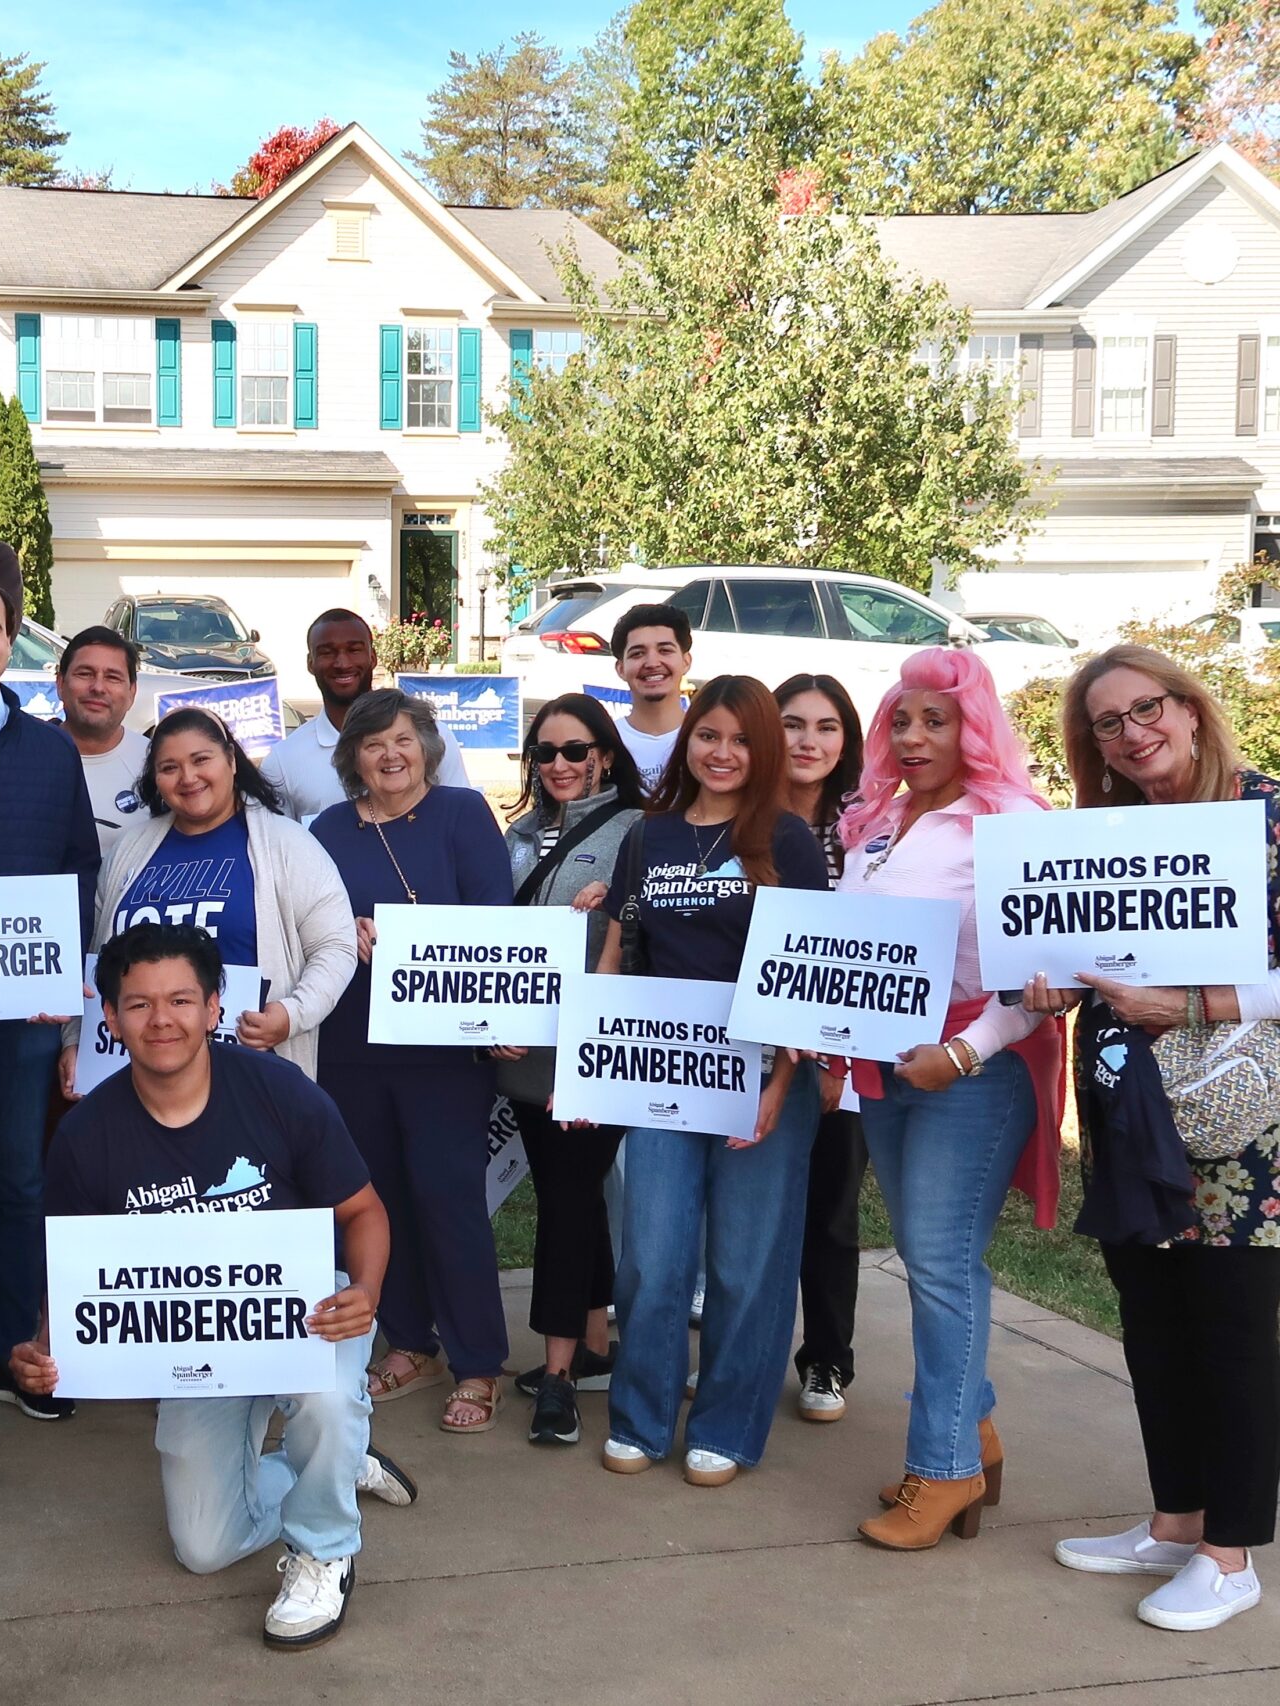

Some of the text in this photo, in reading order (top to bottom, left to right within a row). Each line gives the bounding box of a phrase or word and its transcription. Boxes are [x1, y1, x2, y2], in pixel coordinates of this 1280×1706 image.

[432, 705, 506, 725] nberger
[130, 858, 236, 904] WILL
[1023, 854, 1210, 883] LATINOS FOR
[653, 897, 716, 908] GOVERNOR
[1001, 886, 1238, 937] SPANBERGER
[1, 916, 42, 934] FOR
[411, 944, 548, 963] LATINOS FOR
[783, 933, 918, 965] LATINOS FOR
[391, 969, 561, 1005] SPANBERGER
[757, 959, 931, 1016] SPANBERGER
[598, 1017, 731, 1045] LATINOS FOR
[578, 1042, 746, 1093] SPANBERGER
[125, 1176, 197, 1208] Abigail
[128, 1183, 272, 1215] nberger
[98, 1263, 283, 1290] LATINOS FOR
[75, 1297, 309, 1345] SPANBERGER
